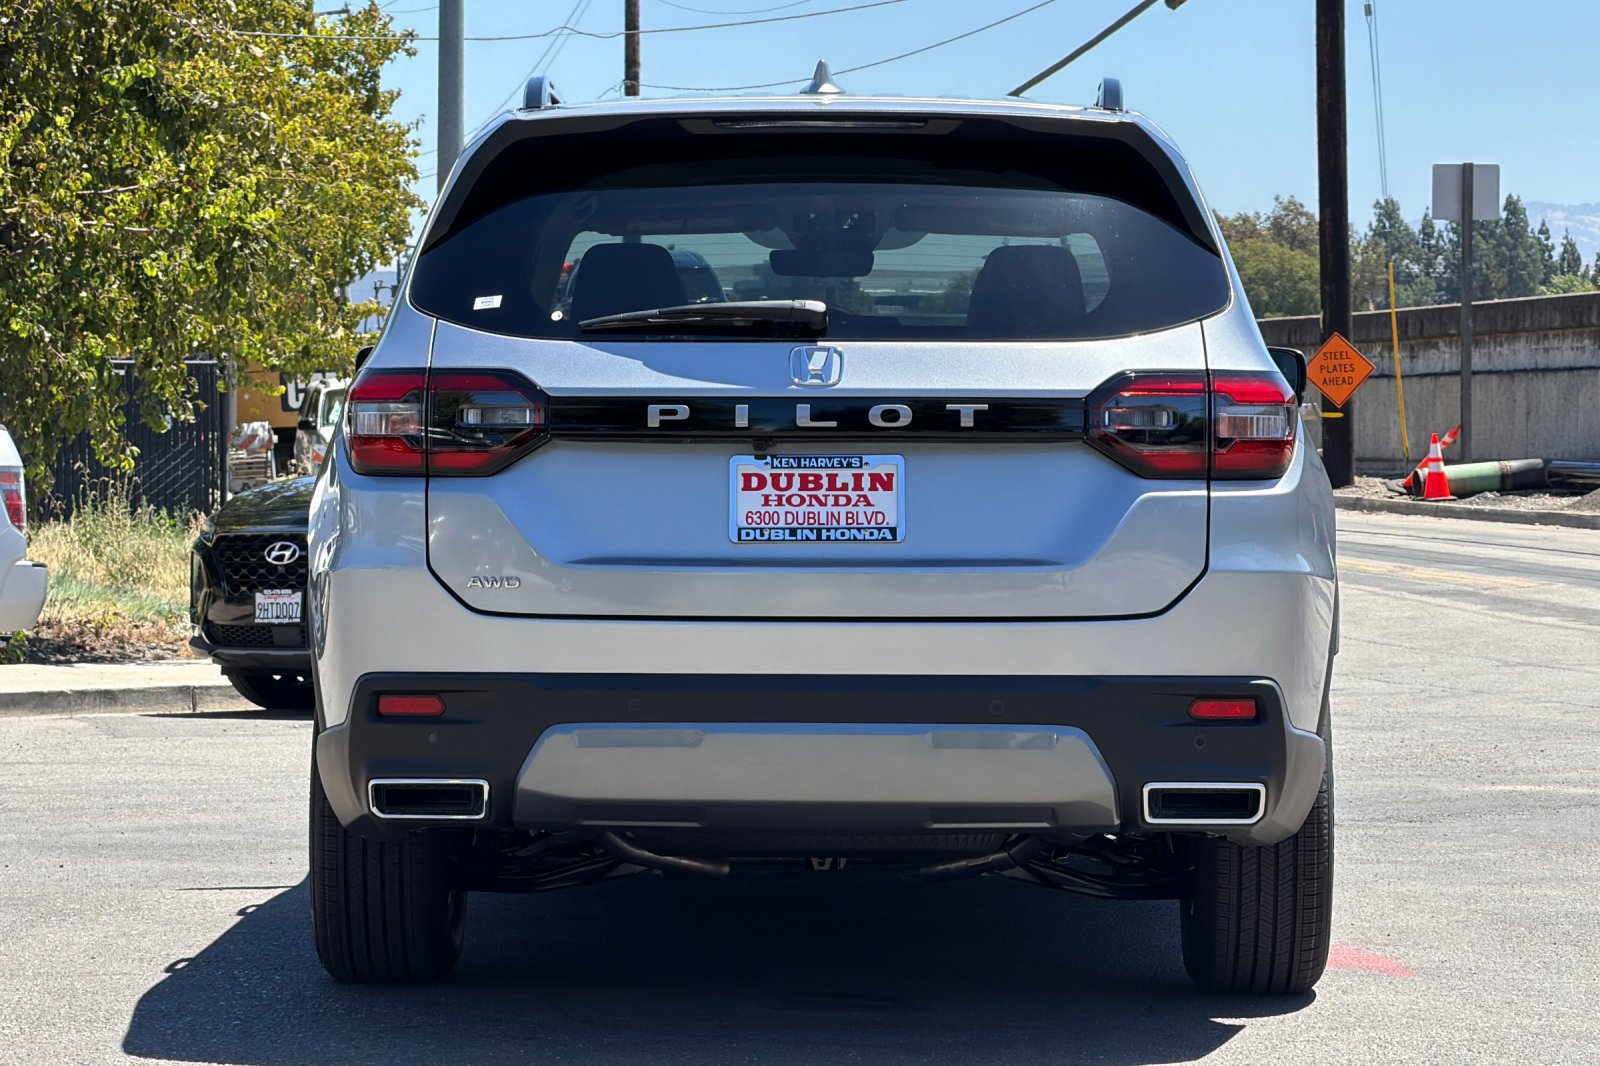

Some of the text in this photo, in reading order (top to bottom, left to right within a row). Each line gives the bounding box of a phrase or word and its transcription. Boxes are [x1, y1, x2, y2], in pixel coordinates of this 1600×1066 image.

[1323, 351, 1351, 360] STEEL
[1320, 363, 1355, 374] PLATES
[1322, 376, 1354, 386] AHEAD
[647, 404, 989, 428] PILOT
[773, 457, 861, 467] KEN HARVEY'S
[741, 473, 895, 491] DUBLIN
[761, 494, 875, 507] HONDA
[745, 511, 890, 525] 6300 DUBLIN BLVD.
[740, 528, 893, 540] DUBLIN HONDA
[466, 576, 521, 588] AWD
[257, 602, 300, 619] 9HTD007
